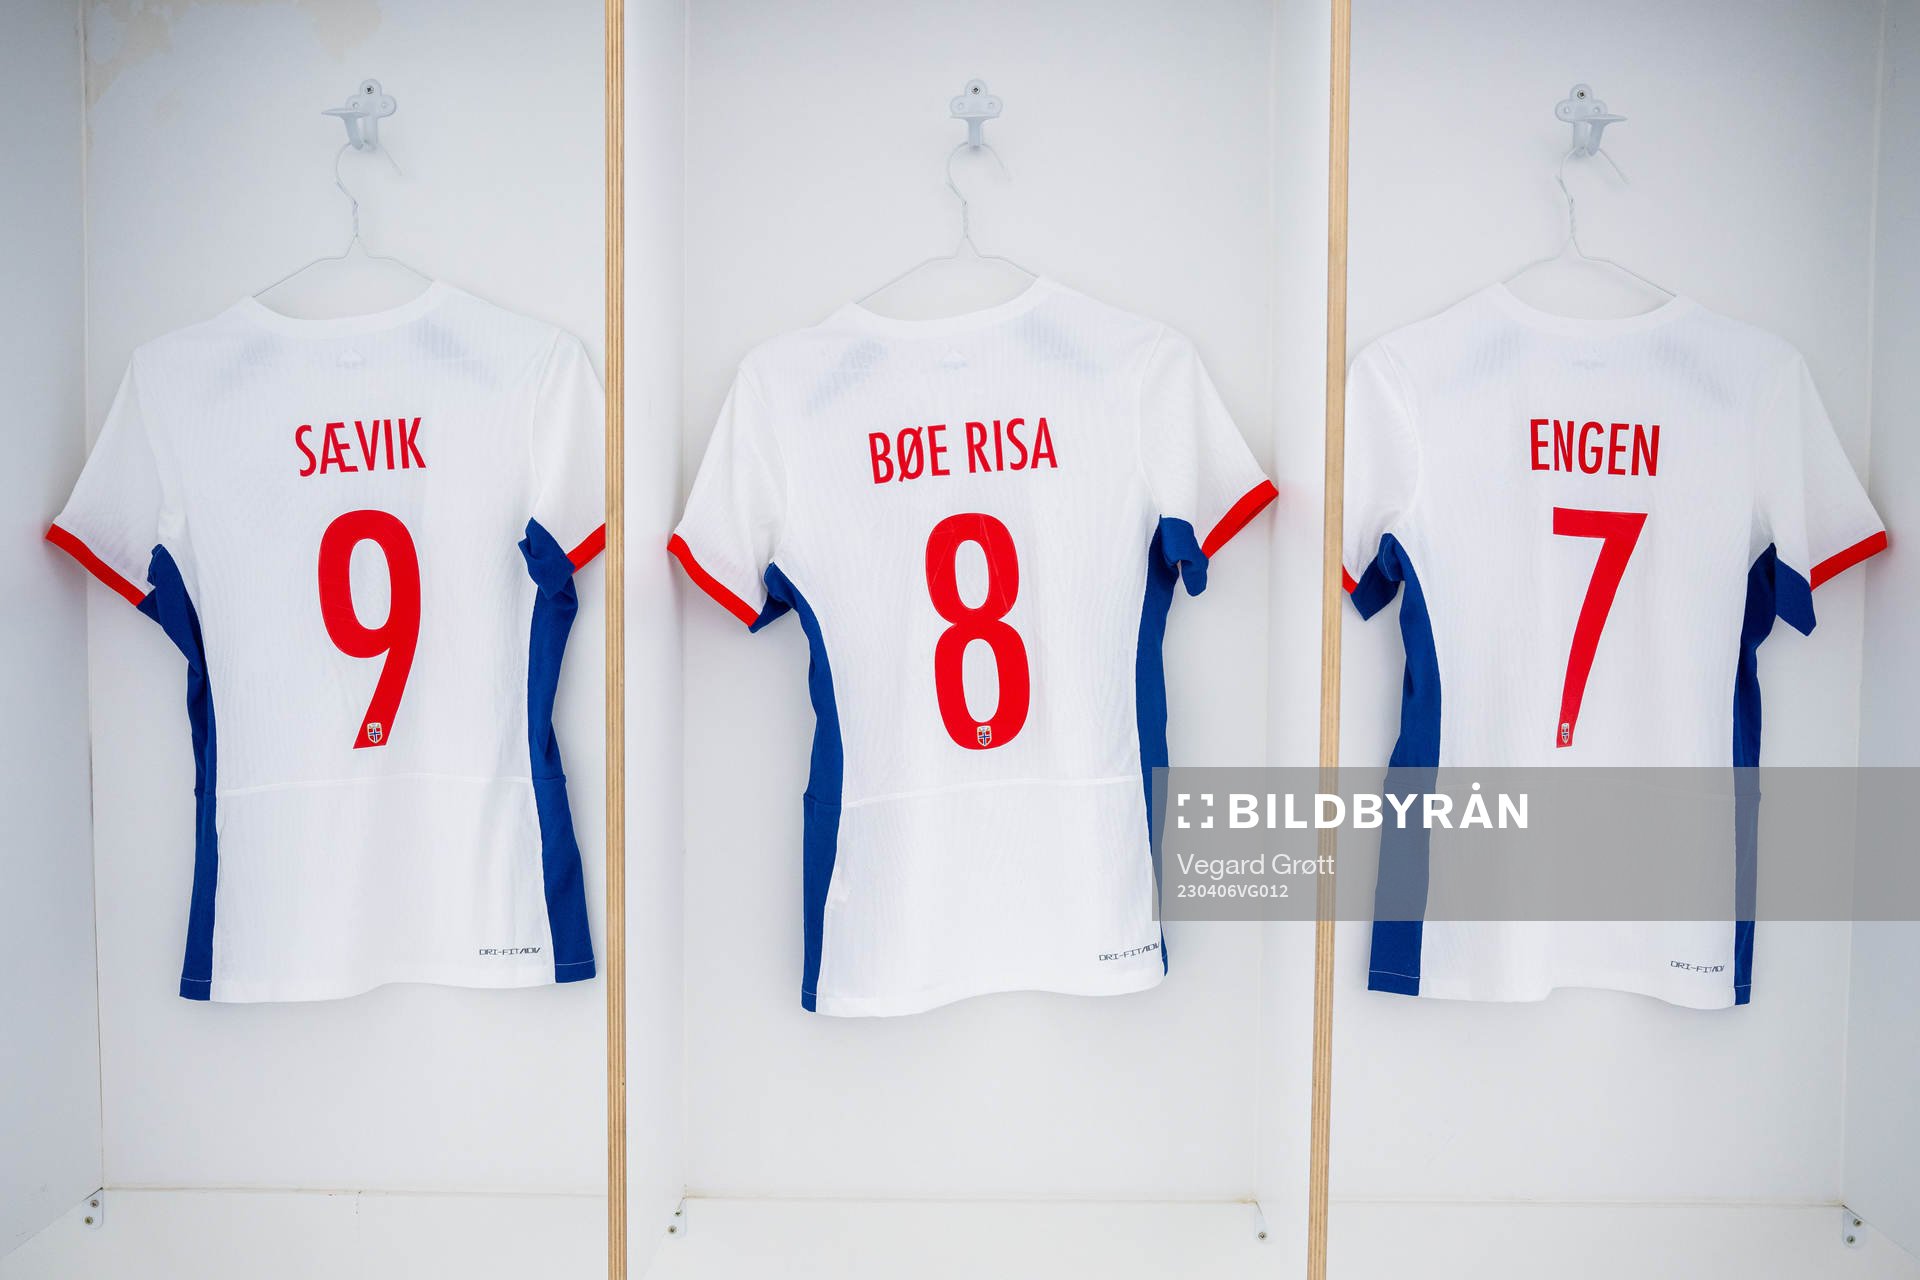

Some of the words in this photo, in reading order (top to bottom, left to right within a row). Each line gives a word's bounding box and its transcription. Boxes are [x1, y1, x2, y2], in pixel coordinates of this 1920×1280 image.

[294, 417, 427, 478] SÆVIK
[868, 423, 951, 485] BØE
[964, 417, 1058, 474] RISA
[1529, 418, 1661, 477] ENGEN
[317, 509, 422, 750] 9
[924, 512, 1031, 751] 8
[1552, 506, 1649, 749] 7
